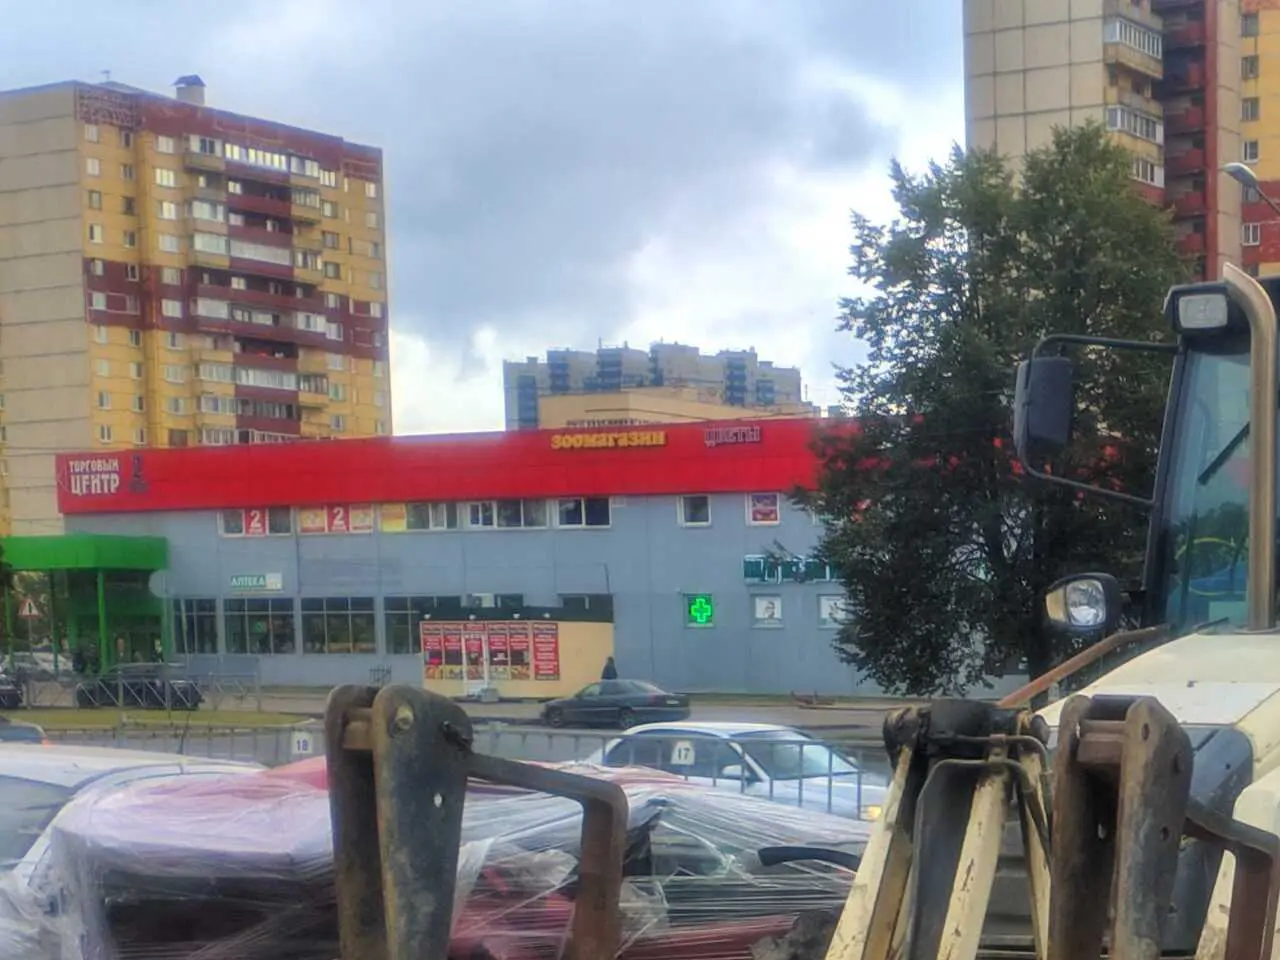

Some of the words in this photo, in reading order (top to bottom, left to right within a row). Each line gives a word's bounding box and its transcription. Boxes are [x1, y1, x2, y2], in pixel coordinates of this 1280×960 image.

[71, 473, 119, 496] ЦЕНТР
[250, 510, 261, 527] 2
[333, 507, 346, 526] 2
[231, 575, 265, 587] АПТЕКА
[678, 747, 690, 760] 17
